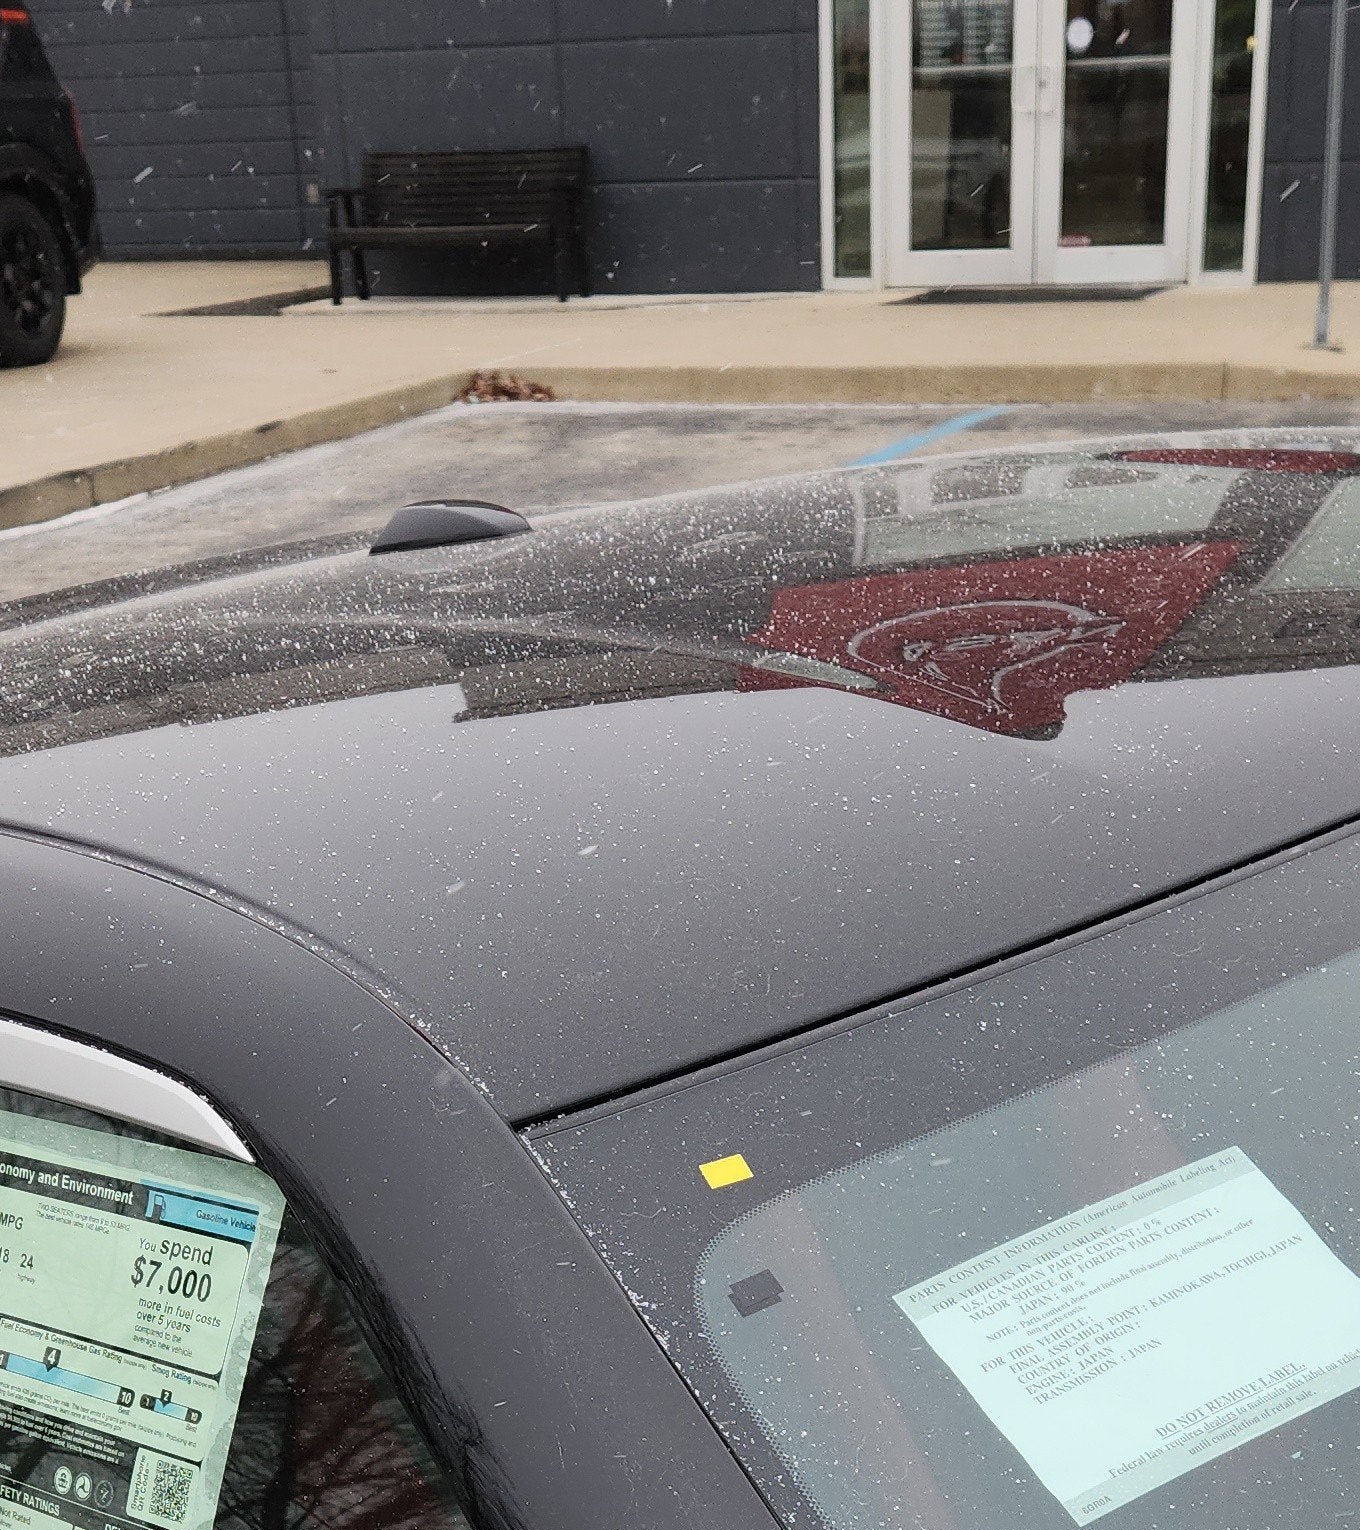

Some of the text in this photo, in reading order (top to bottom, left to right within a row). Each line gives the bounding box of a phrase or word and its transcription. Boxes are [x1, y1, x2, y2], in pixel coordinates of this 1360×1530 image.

[37, 1169, 59, 1187] and
[60, 1174, 135, 1205] Environment
[196, 1210, 228, 1224] Gasoline
[908, 1156, 1236, 1303] PARTS CONTENT INFORMATION (American Automobile Labeling Act)
[20, 1254, 34, 1270] 24
[140, 1238, 214, 1266] You spend
[1046, 1252, 1084, 1274] PARTS
[1144, 1222, 1150, 1230] 0
[1150, 1218, 1162, 1226] %
[130, 1254, 212, 1302] $7,000
[930, 1296, 958, 1312] FOR
[958, 1268, 1016, 1298] VEHICLES
[1016, 1262, 1032, 1272] IN
[1032, 1248, 1060, 1264] THIS
[968, 1300, 1010, 1323] MAJOR
[1012, 1278, 1058, 1304] SOURCE
[1058, 1268, 1074, 1282] OF
[1076, 1246, 1128, 1273] FOREIGN
[1128, 1230, 1162, 1250] PARTS
[1060, 1284, 1074, 1295] 90
[1074, 1278, 1086, 1288] %
[136, 1310, 192, 1332] over 5 years
[138, 1298, 222, 1328] more in fuel costs
[0, 1320, 14, 1330] Fuel
[14, 1324, 43, 1340] Economy
[50, 1334, 88, 1352] Greenhouse
[88, 1345, 102, 1356] Gas
[102, 1349, 122, 1363] Rating
[45, 1347, 57, 1365] 4
[980, 1356, 1006, 1372] FOR
[1008, 1342, 1034, 1360] THIS
[1008, 1354, 1044, 1374] FINAL
[1048, 1320, 1104, 1357] ASSEMBLY
[1078, 1346, 1114, 1370] JAPAN
[152, 1364, 192, 1384] Smog Rating
[1018, 1354, 1070, 1384] COUNTRY
[1074, 1342, 1090, 1356] OF
[1034, 1340, 1162, 1404] TRANSMISSION JAPAN
[120, 1392, 132, 1404] 10
[1154, 1362, 1307, 1438] DO NOT REMOVE LABEL.
[1108, 1454, 1147, 1478] Federal
[1144, 1448, 1164, 1460] law
[1164, 1428, 1206, 1452] requires
[1204, 1412, 1238, 1430] dealers
[1236, 1406, 1246, 1416] to
[1246, 1388, 1288, 1410] maintain
[1286, 1378, 1305, 1390] this
[1300, 1366, 1326, 1382] label
[1324, 1362, 1338, 1372] on
[1186, 1390, 1316, 1455] until completion of retail sale.
[12, 1510, 31, 1526] Rated
[22, 1490, 60, 1518] RATINGS
